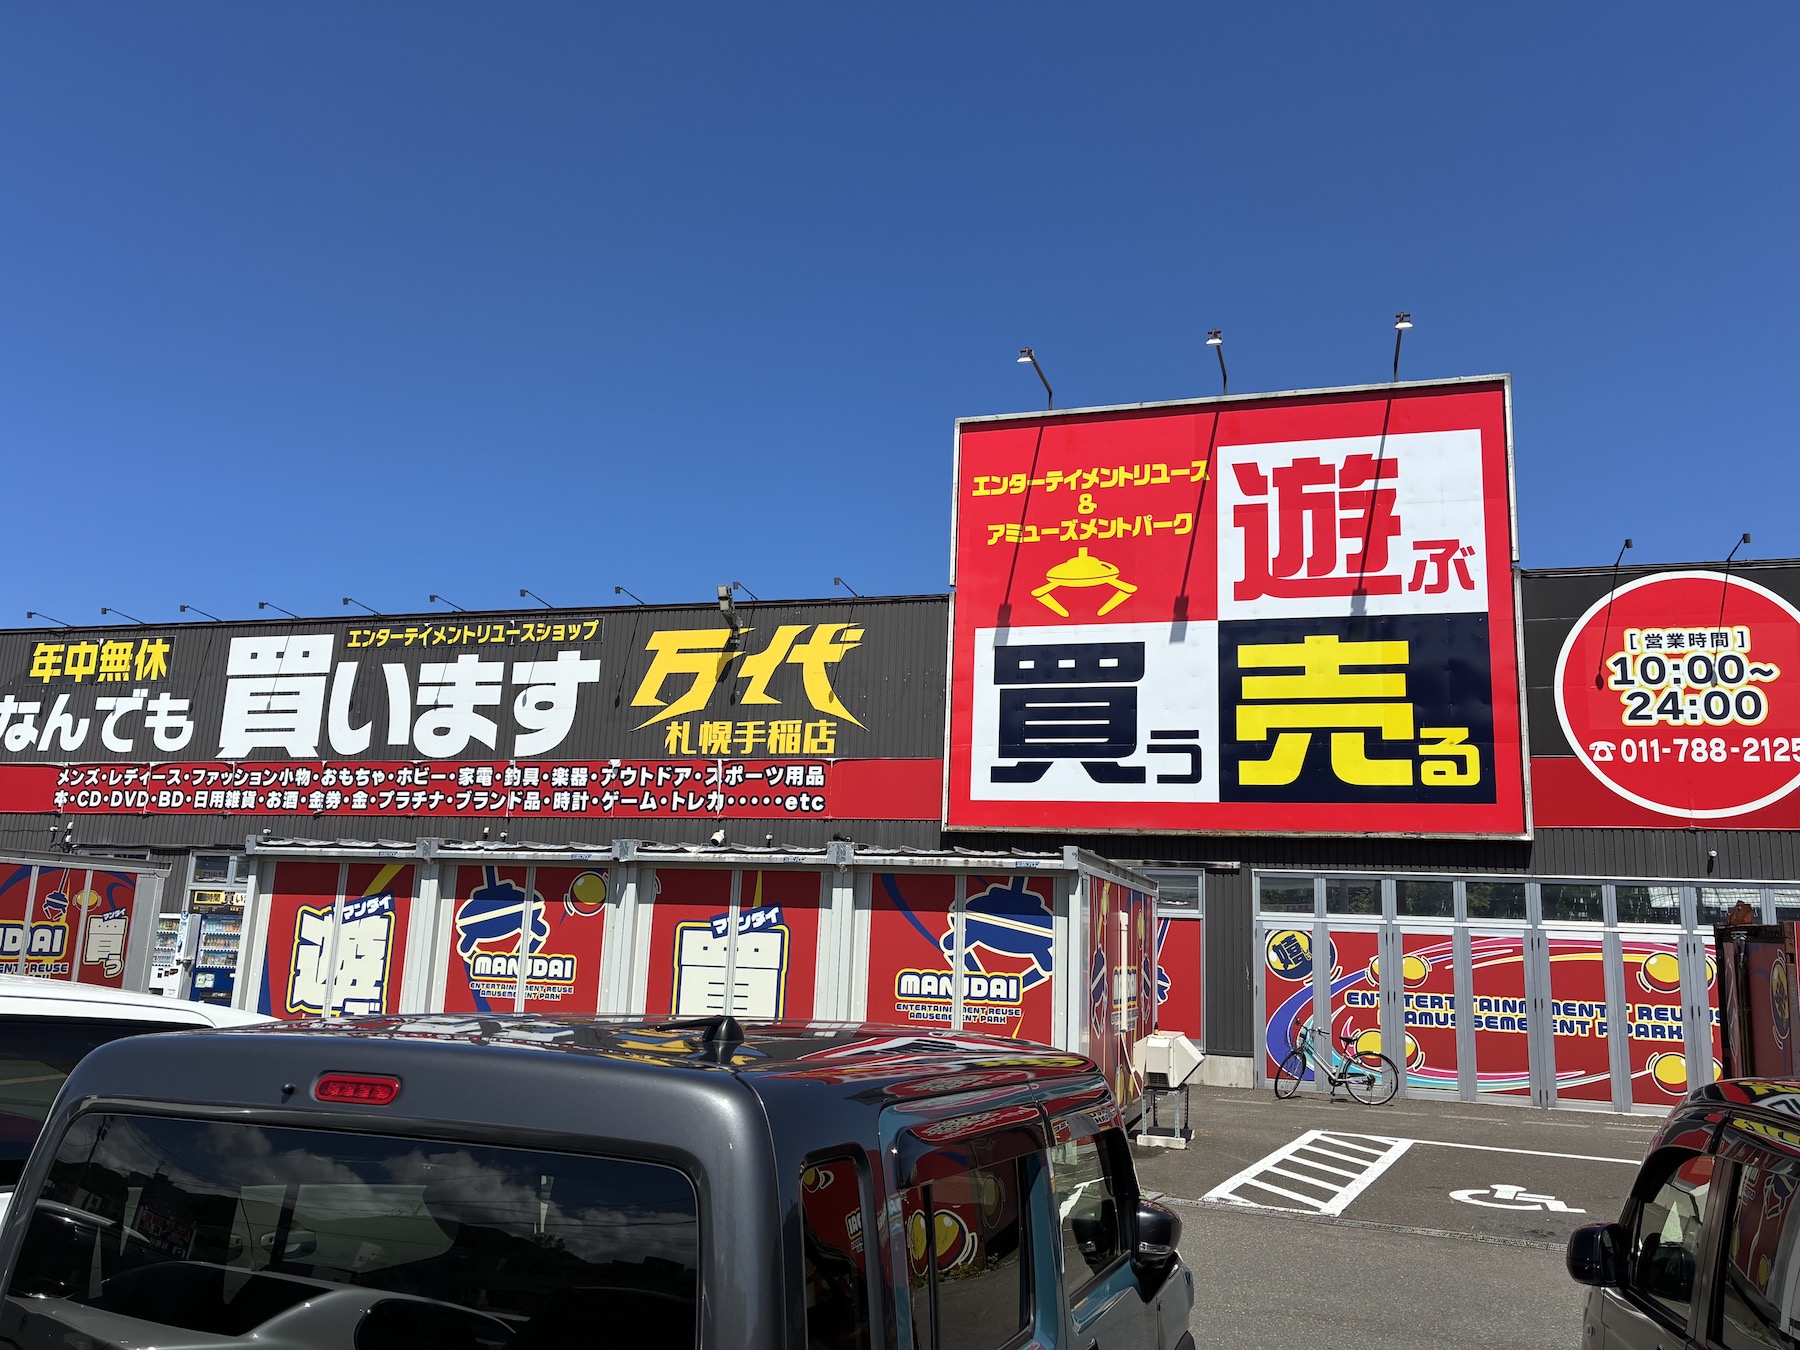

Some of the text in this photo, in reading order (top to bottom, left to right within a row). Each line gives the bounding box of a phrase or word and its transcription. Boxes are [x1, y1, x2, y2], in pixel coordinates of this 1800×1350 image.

[972, 459, 1210, 497] エンターテイメントリユース
[1078, 494, 1098, 514] &
[987, 512, 1194, 546] アミューズメントパーク
[1232, 453, 1476, 602] 遊ぶ
[347, 619, 599, 649] エンターテイメントリユースショップ
[29, 638, 170, 683] 年中無休
[630, 622, 870, 732] 万代
[0, 634, 600, 758] なんでも 買います
[1235, 634, 1482, 788] 売る
[1627, 689, 1763, 721] 24:00
[990, 641, 1202, 785] 買う
[665, 719, 837, 755] 札幌手稲店
[1621, 737, 1800, 763] 011-788-2125
[103, 908, 126, 920] マンダイ
[335, 895, 392, 920] マンダイ
[713, 907, 779, 934] マンダイ
[0, 928, 63, 952] DAI
[85, 918, 127, 976] 買う
[30, 964, 68, 973] REUSE
[475, 957, 572, 978] MANDAI
[901, 975, 1017, 999] MANDAI
[981, 1015, 1006, 1023] PARK
[989, 1008, 1021, 1016] REUSE
